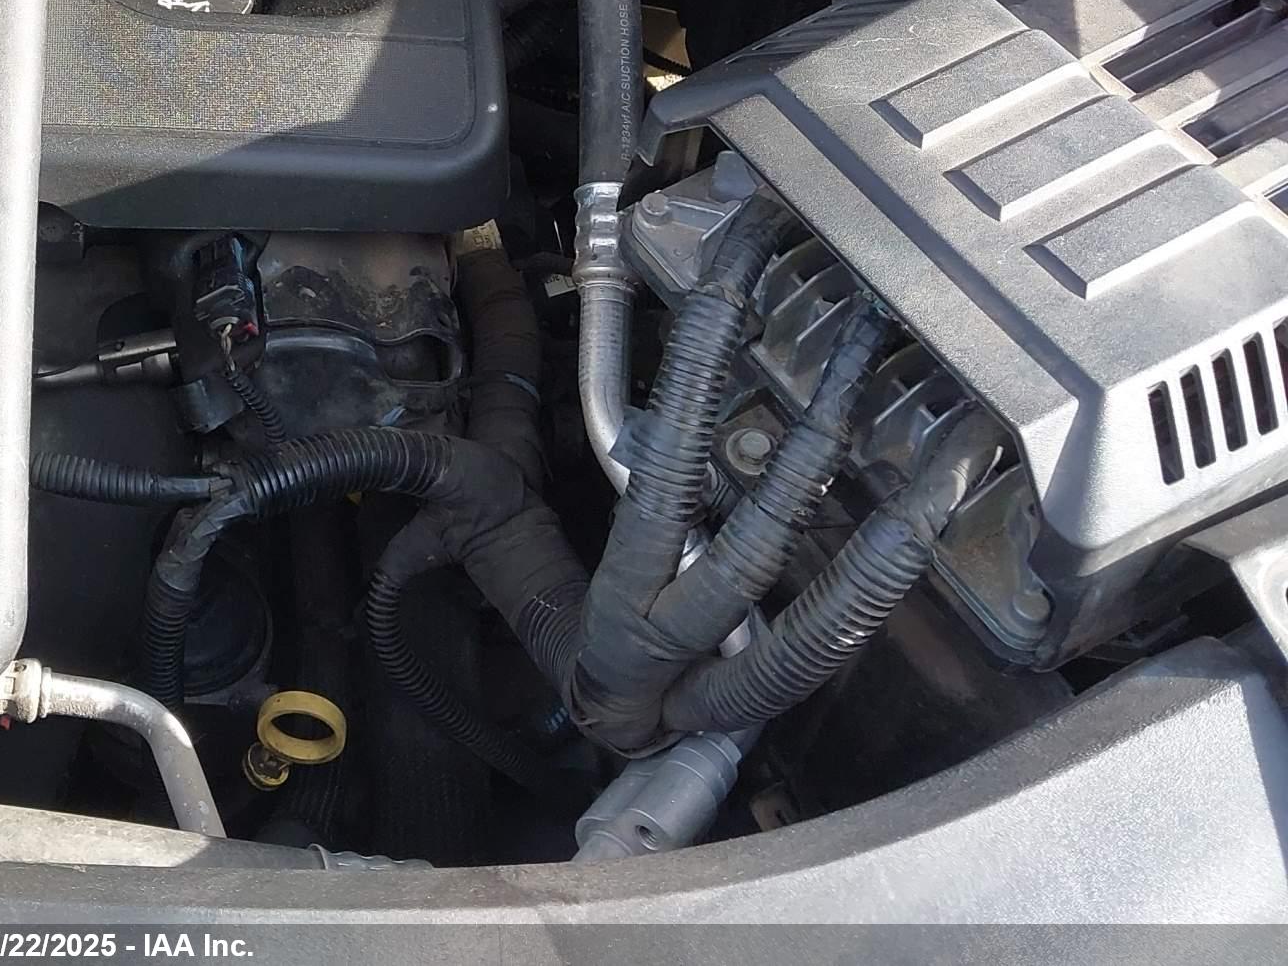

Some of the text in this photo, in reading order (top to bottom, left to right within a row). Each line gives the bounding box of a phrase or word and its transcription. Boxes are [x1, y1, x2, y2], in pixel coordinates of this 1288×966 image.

[619, 3, 629, 36] HOSE
[620, 38, 631, 90] SUCTION
[620, 94, 631, 113] A/C
[620, 114, 632, 161] R-1234yf
